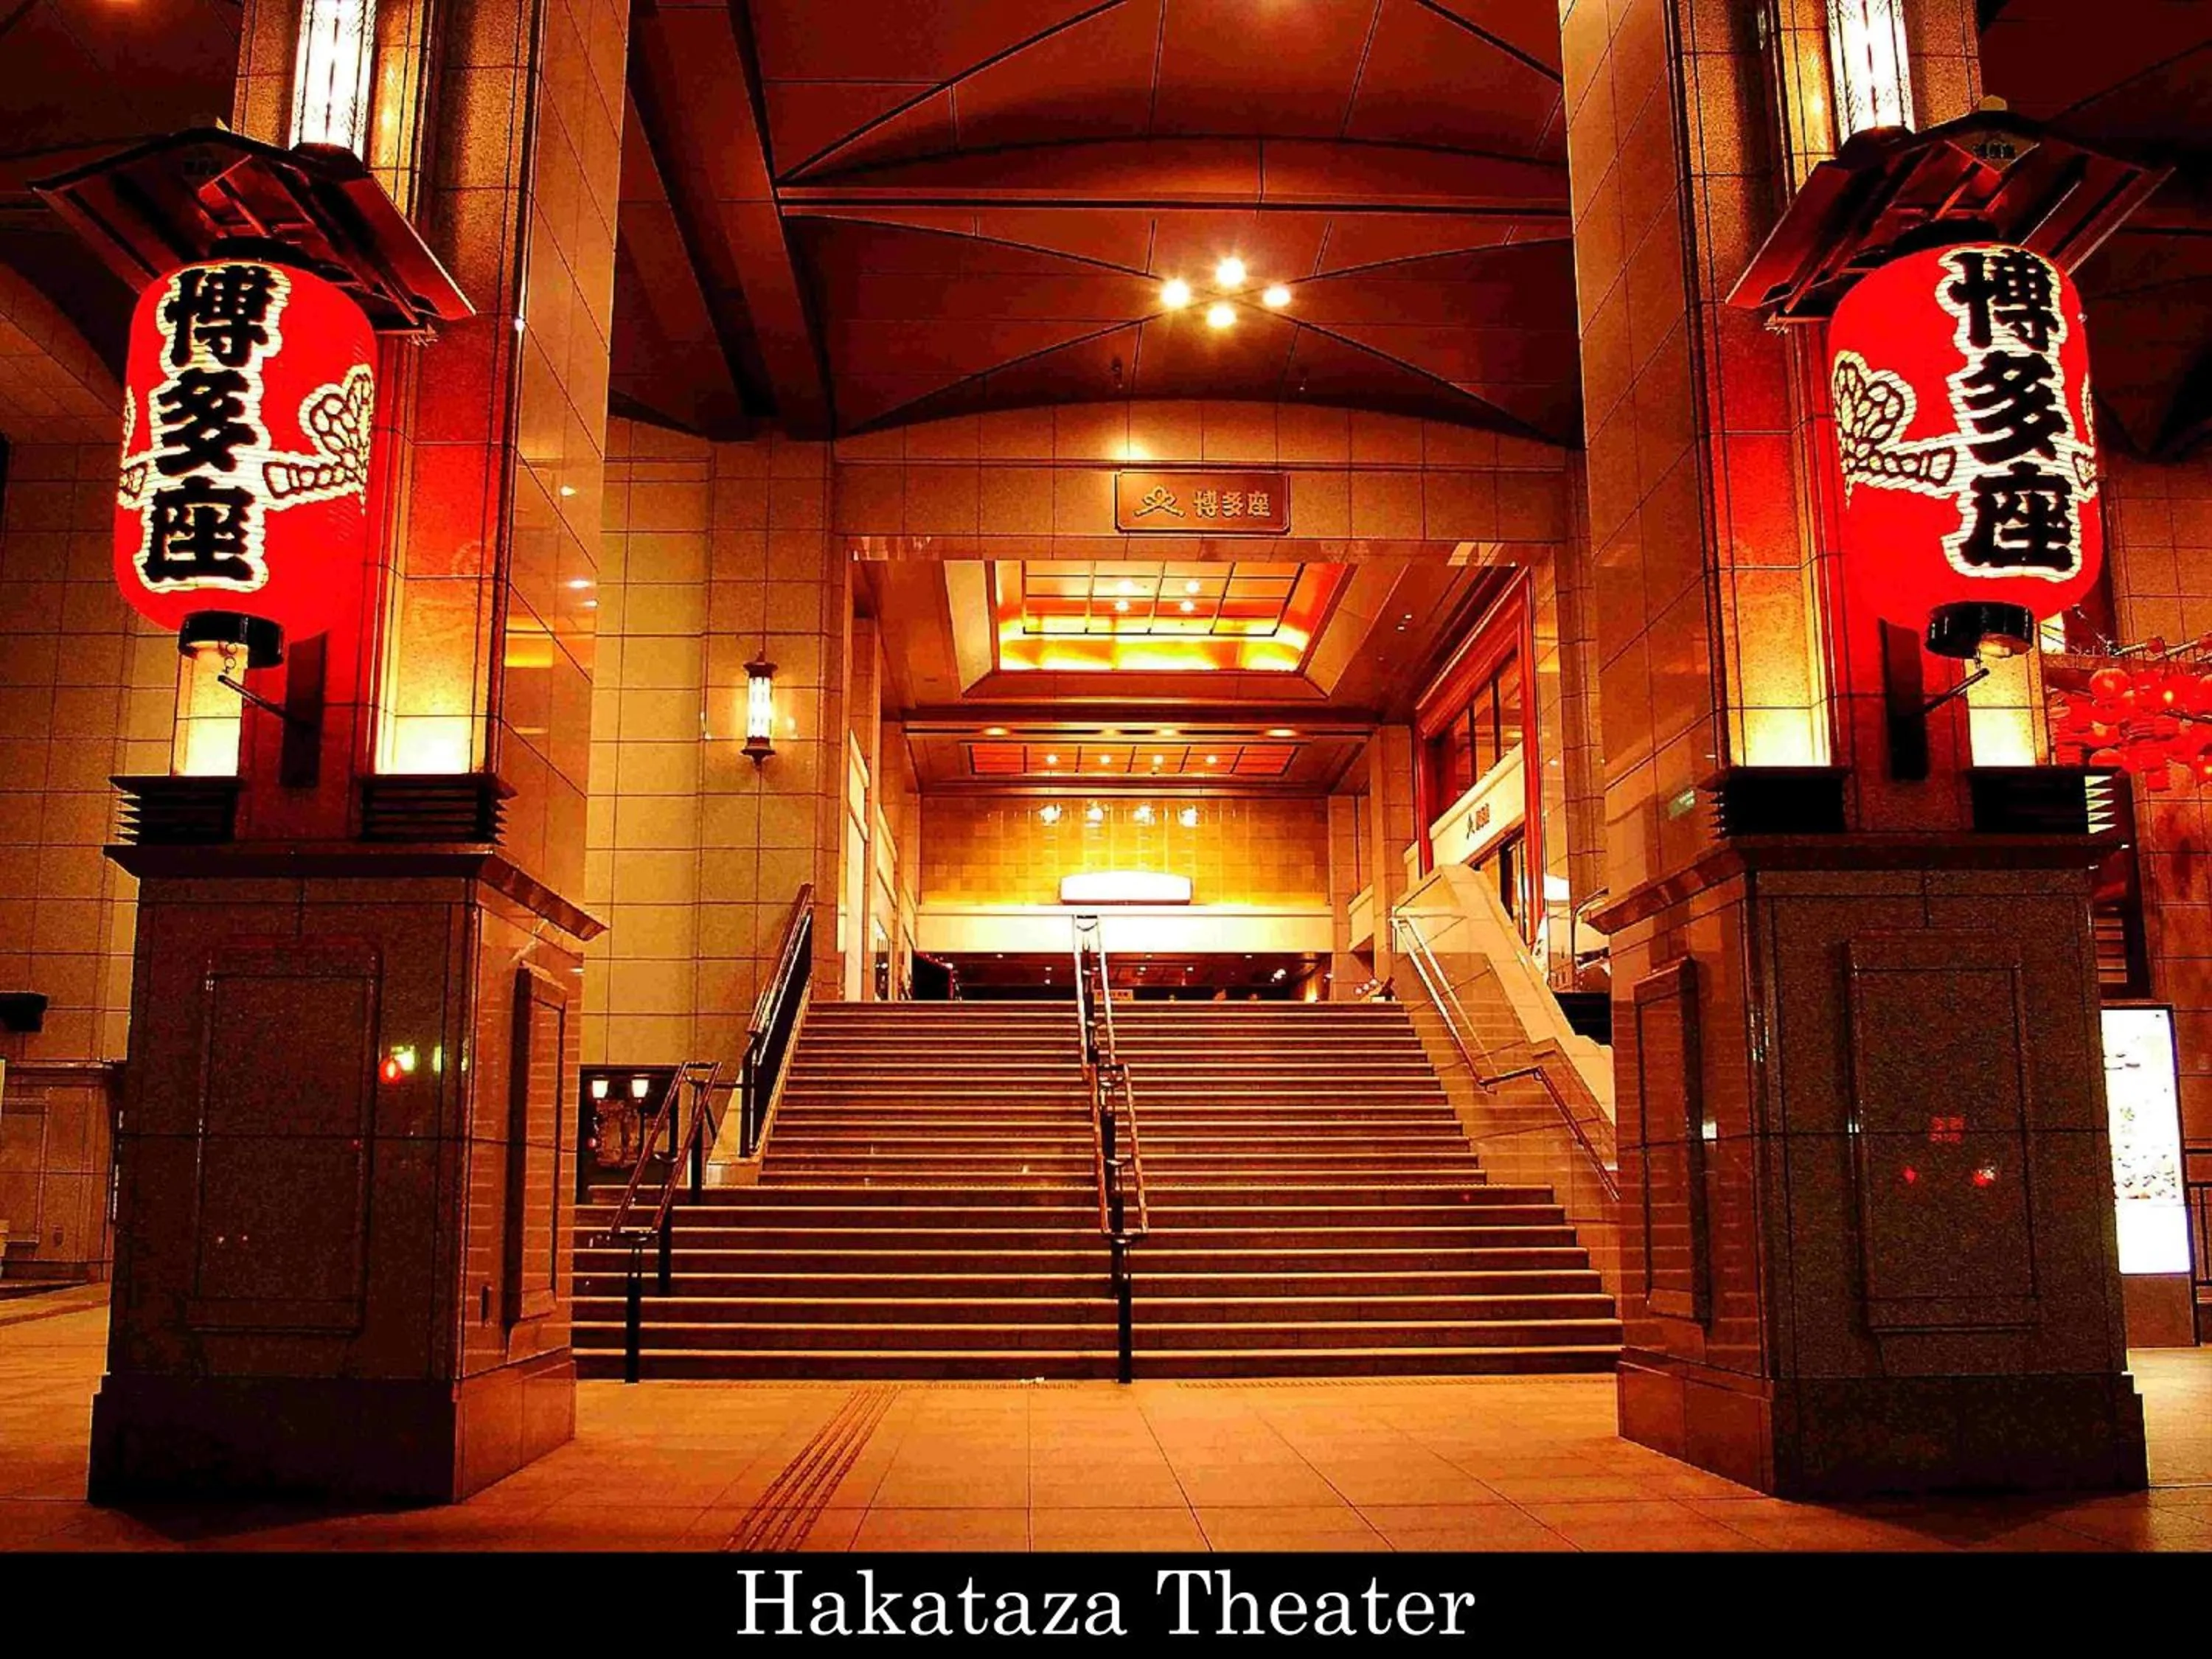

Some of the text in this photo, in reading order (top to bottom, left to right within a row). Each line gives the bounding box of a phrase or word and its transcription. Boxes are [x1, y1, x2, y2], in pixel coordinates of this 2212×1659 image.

[141, 265, 278, 582] 博多座
[1194, 490, 1271, 518] 博多座
[1947, 250, 2073, 571] 博多座
